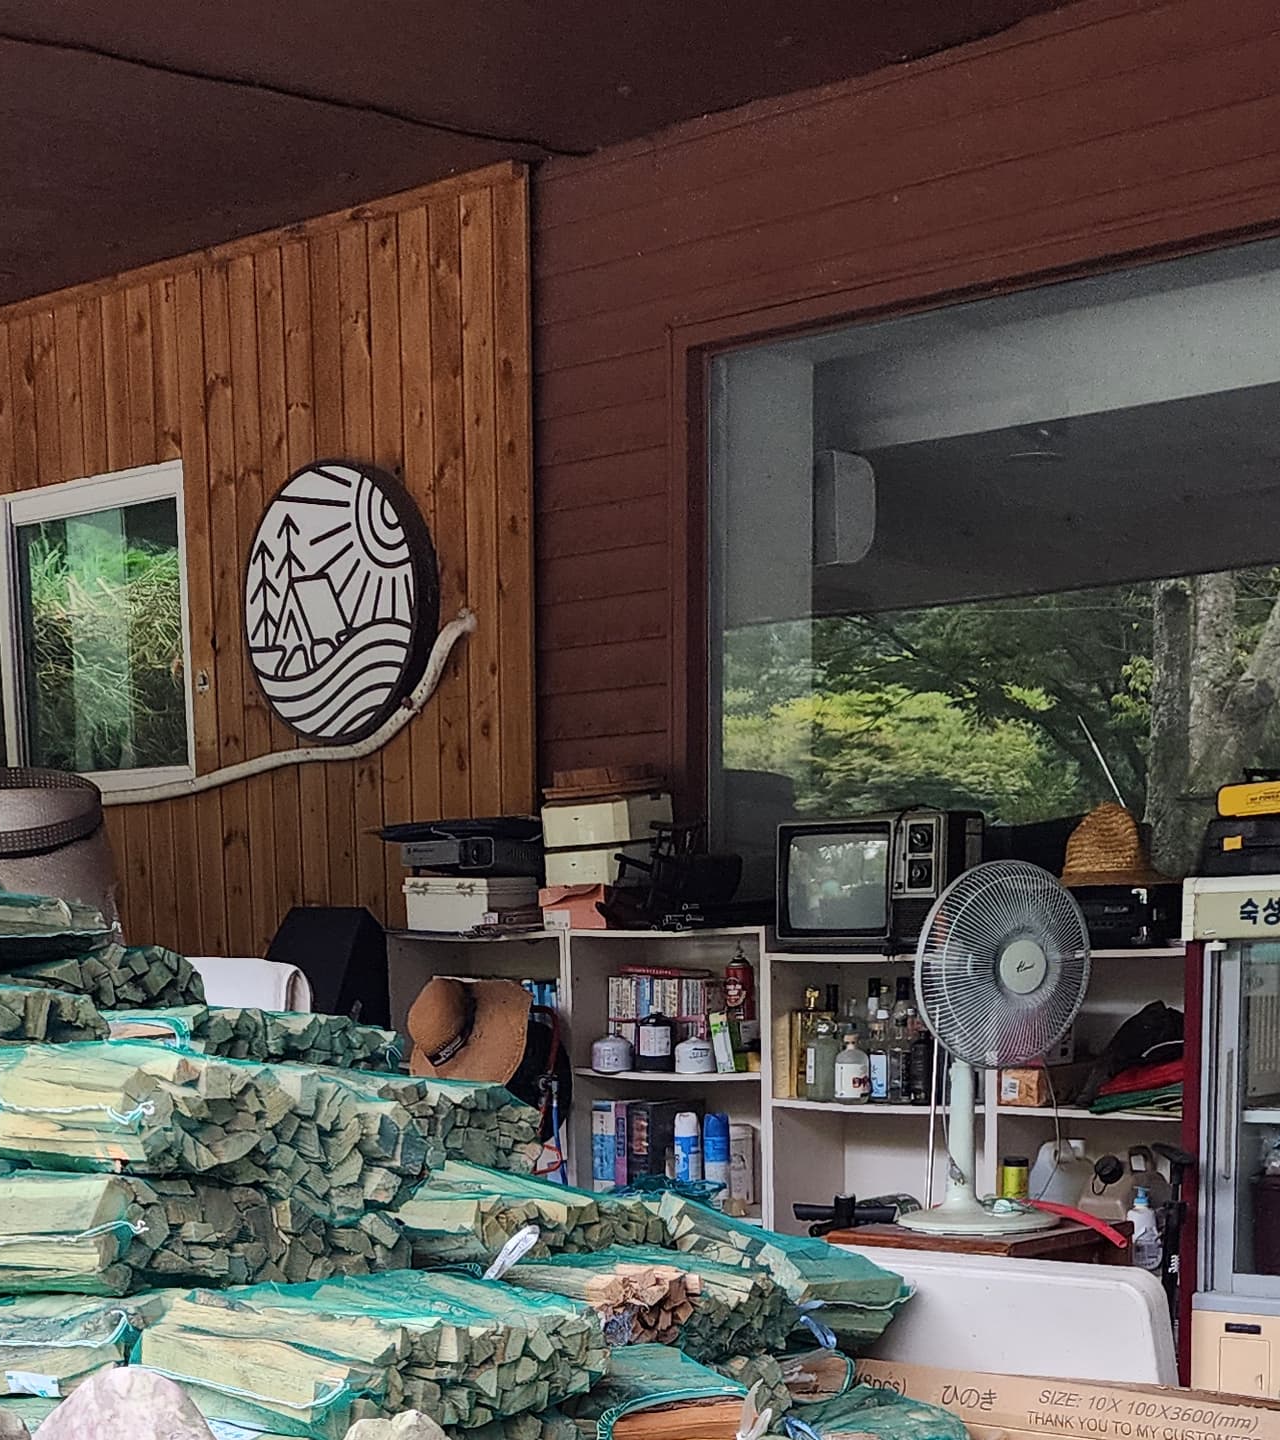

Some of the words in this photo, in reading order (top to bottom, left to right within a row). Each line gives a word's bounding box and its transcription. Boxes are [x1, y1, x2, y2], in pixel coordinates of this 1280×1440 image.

[941, 1385, 998, 1411] ひのき
[1038, 1390, 1083, 1409] SIZE:
[1026, 1411, 1075, 1430] THANK
[1078, 1416, 1108, 1433] YOU
[1111, 1421, 1132, 1437] TO
[1136, 1424, 1159, 1440] MY
